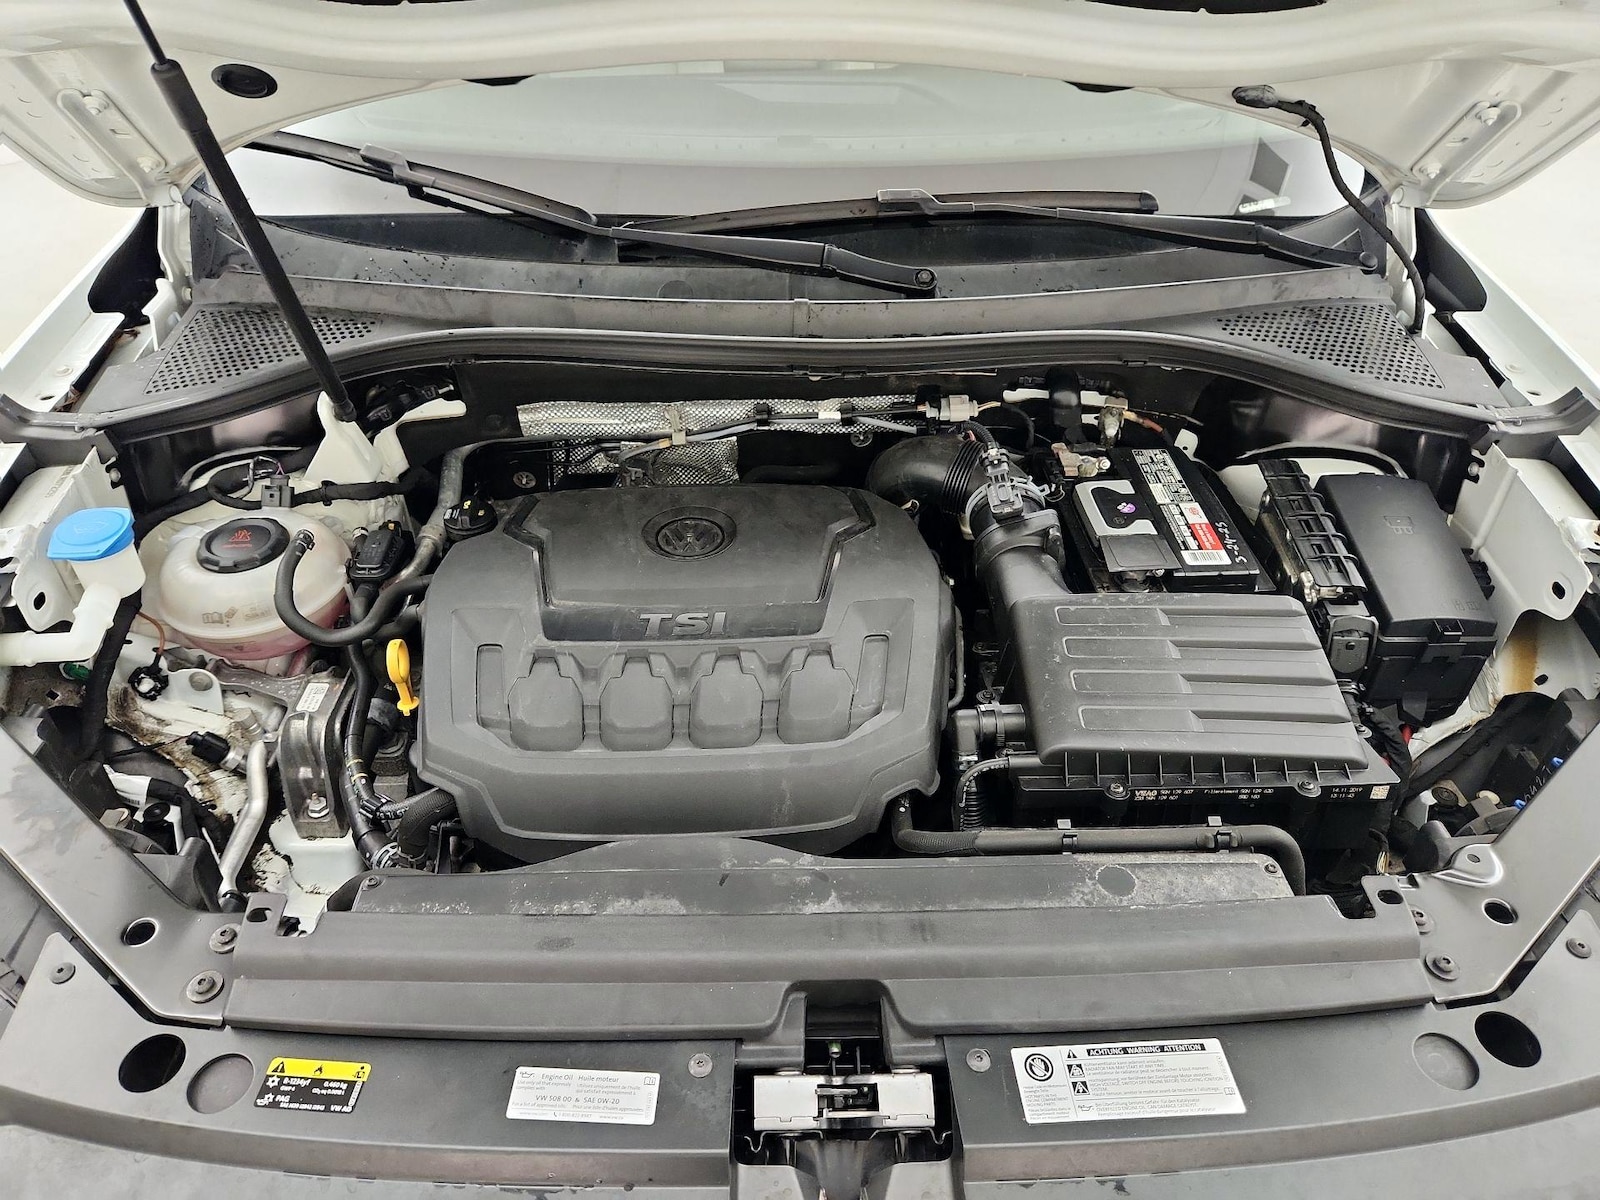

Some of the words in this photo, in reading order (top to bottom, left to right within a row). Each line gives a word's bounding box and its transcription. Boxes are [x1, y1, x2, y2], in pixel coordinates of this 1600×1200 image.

[639, 611, 727, 637] TSI
[1090, 1048, 1124, 1056] ACHTUNG
[1127, 1046, 1160, 1055] WARNING
[1164, 1044, 1202, 1053] ATTENTION
[541, 1073, 563, 1081] Engine
[283, 1077, 311, 1087] R-1234yf
[340, 1082, 348, 1090] kg
[275, 1095, 290, 1103] PAG
